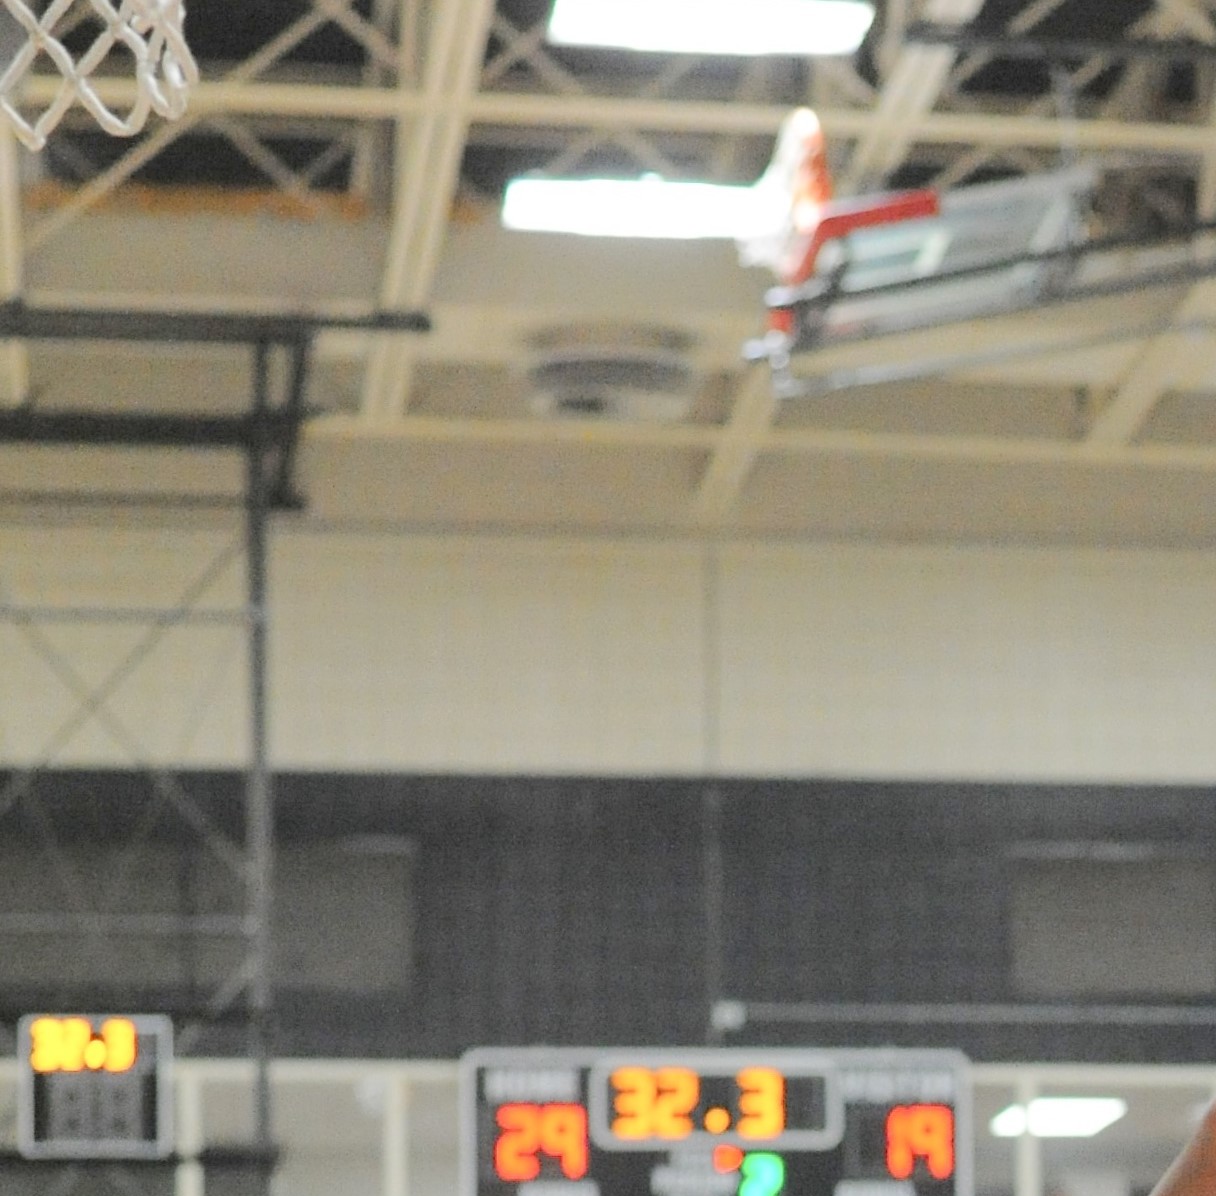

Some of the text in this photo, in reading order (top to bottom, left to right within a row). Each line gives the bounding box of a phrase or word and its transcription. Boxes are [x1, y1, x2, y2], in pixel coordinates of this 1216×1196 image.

[493, 1102, 589, 1181] 29
[611, 1066, 786, 1140] 32.3
[885, 1102, 955, 1180] 19
